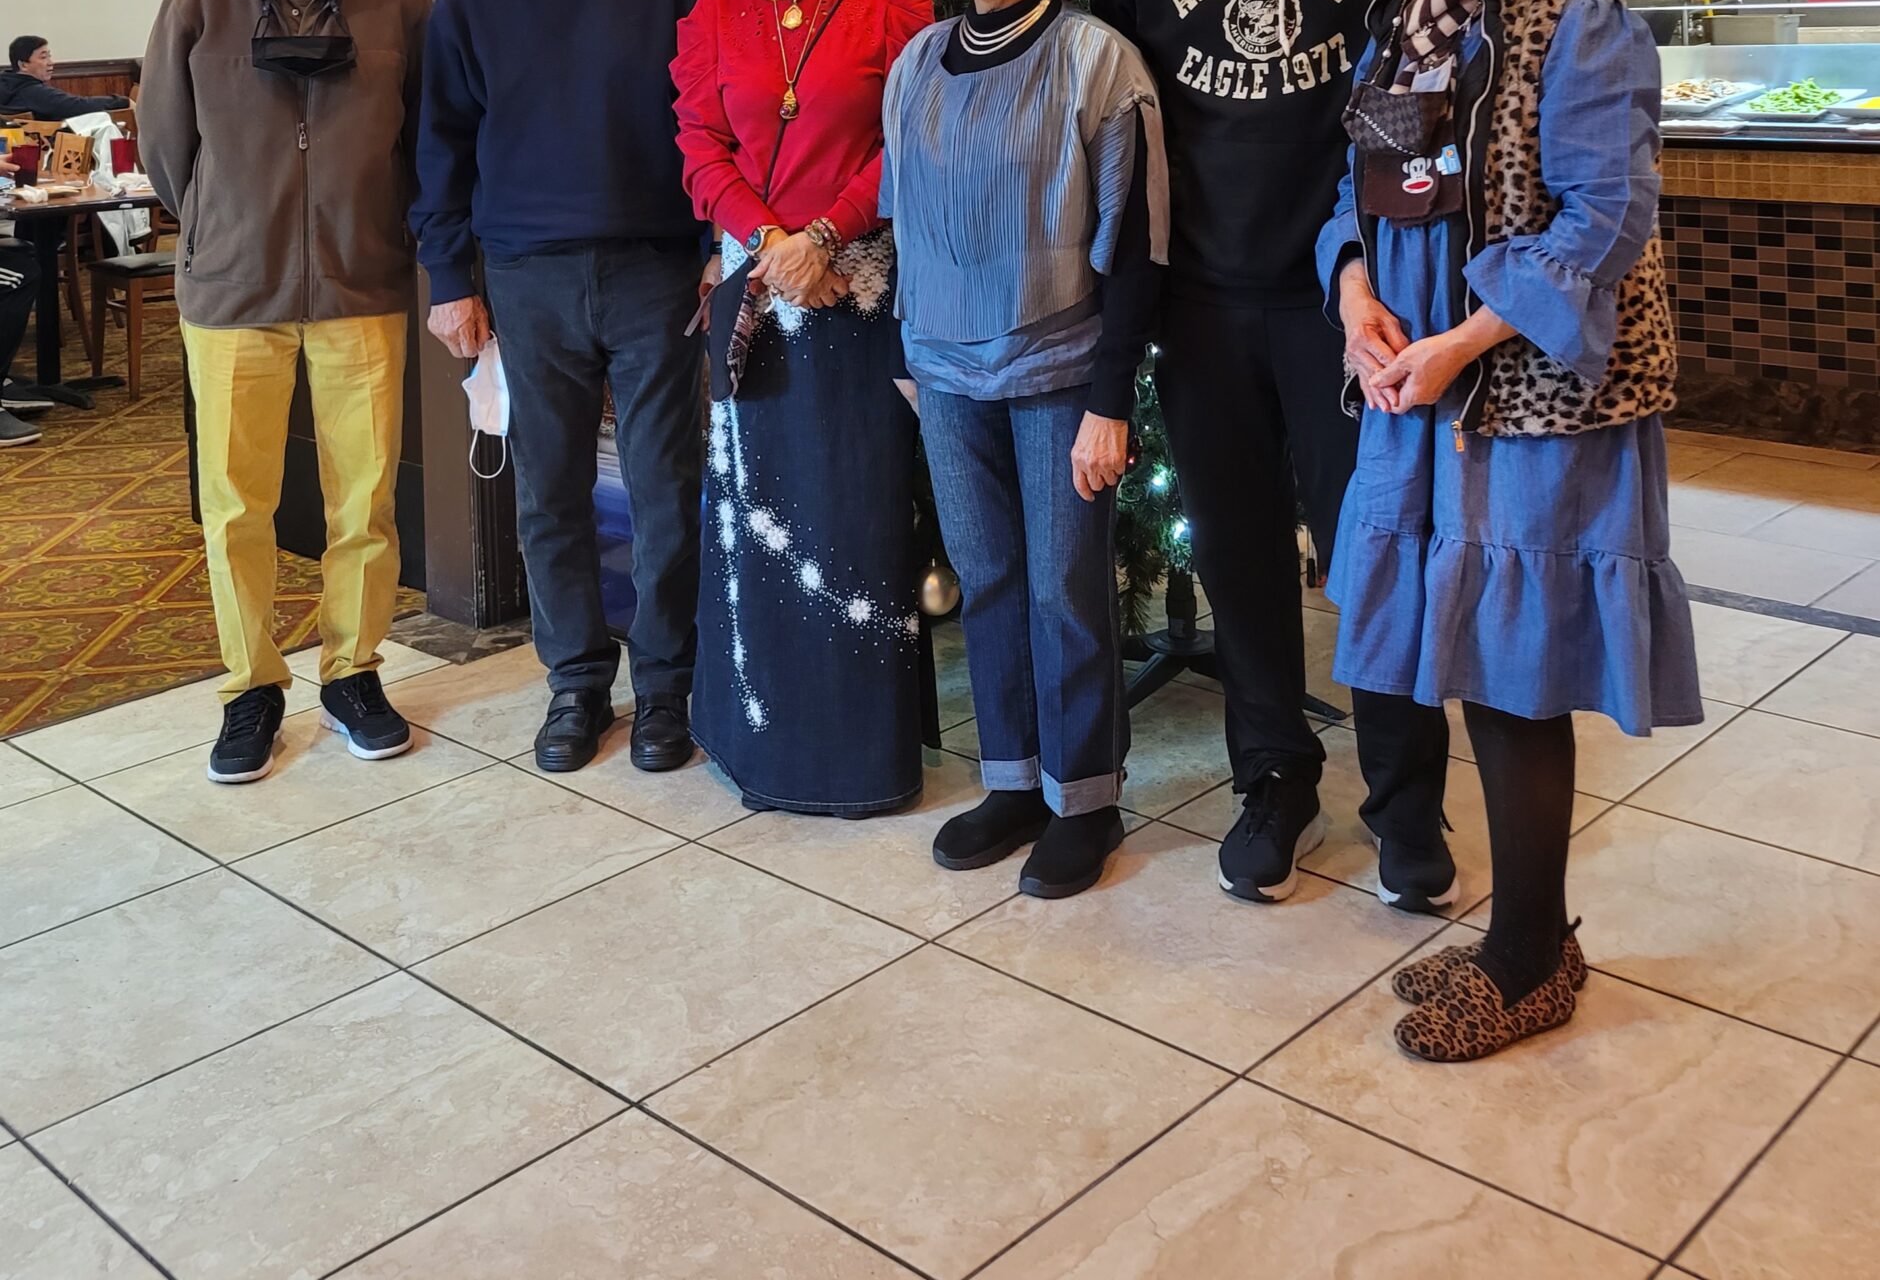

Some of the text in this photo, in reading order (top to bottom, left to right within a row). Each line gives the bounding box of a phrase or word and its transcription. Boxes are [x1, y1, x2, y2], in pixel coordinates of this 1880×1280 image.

[1230, 23, 1267, 53] AMERICAN
[1176, 32, 1353, 100] EAGLE 1977
